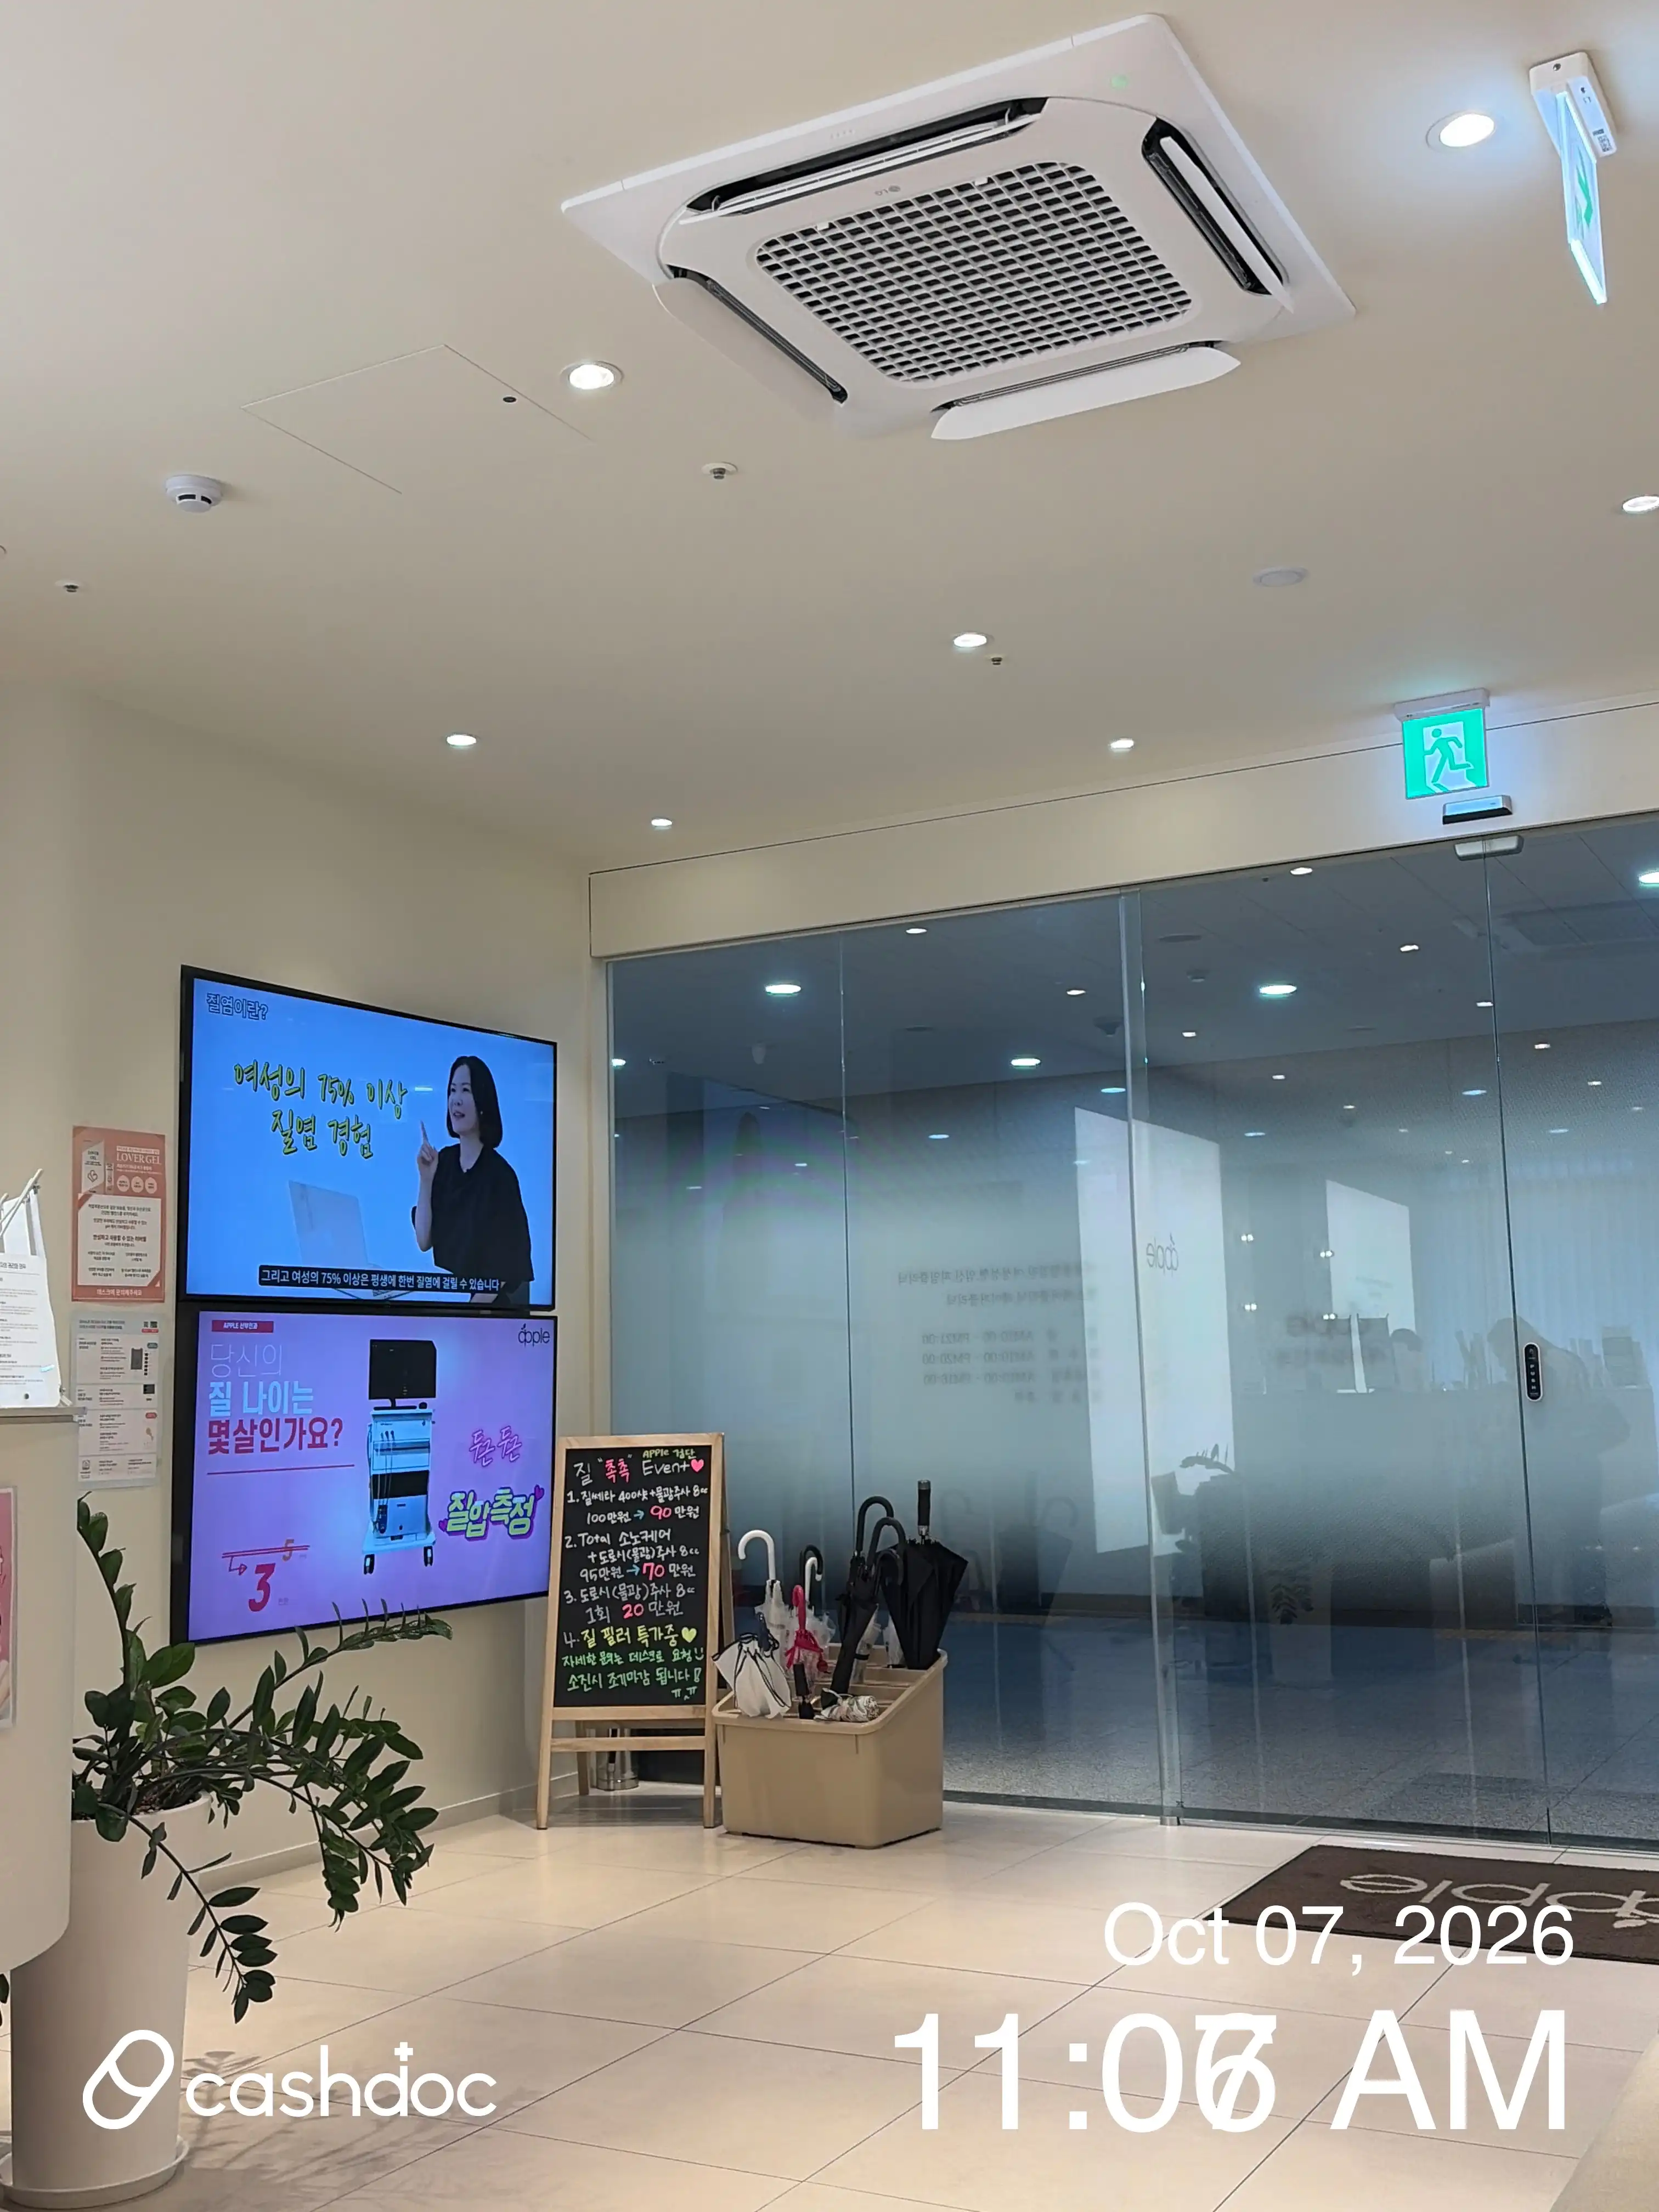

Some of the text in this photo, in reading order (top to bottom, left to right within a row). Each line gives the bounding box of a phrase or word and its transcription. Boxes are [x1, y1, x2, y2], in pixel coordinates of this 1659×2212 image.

[206, 992, 268, 1020] 질염이란?
[234, 1059, 408, 1119] 여성의 75% 이상
[272, 1109, 373, 1159] 질염 경험
[261, 1269, 500, 1291] 그리고 여성의 75% 이상은 평생에 한번 질염에 걸릴 수 있습니다
[518, 1323, 550, 1347] apple
[211, 1345, 283, 1378] 당신의
[209, 1380, 313, 1417] 질 나이는
[208, 1417, 343, 1454] 몇살인가요?
[673, 1449, 696, 1459] 검단
[573, 1462, 592, 1486] 질
[642, 1459, 690, 1476] Event
[446, 1487, 535, 1541] 질압측정
[587, 1510, 631, 1525] 100만원
[618, 1528, 671, 1547] 소노케어
[580, 1565, 624, 1583] 95만원
[249, 1563, 276, 1612] 3
[585, 1604, 611, 1624] 1회
[580, 1628, 597, 1649] 질
[600, 1626, 631, 1646] 필러
[637, 1624, 679, 1647] 특가중
[561, 1648, 692, 1668] 자세한 문의는 데스크로 요청
[567, 1673, 602, 1692] 소진시
[607, 1669, 650, 1689] 조기마감
